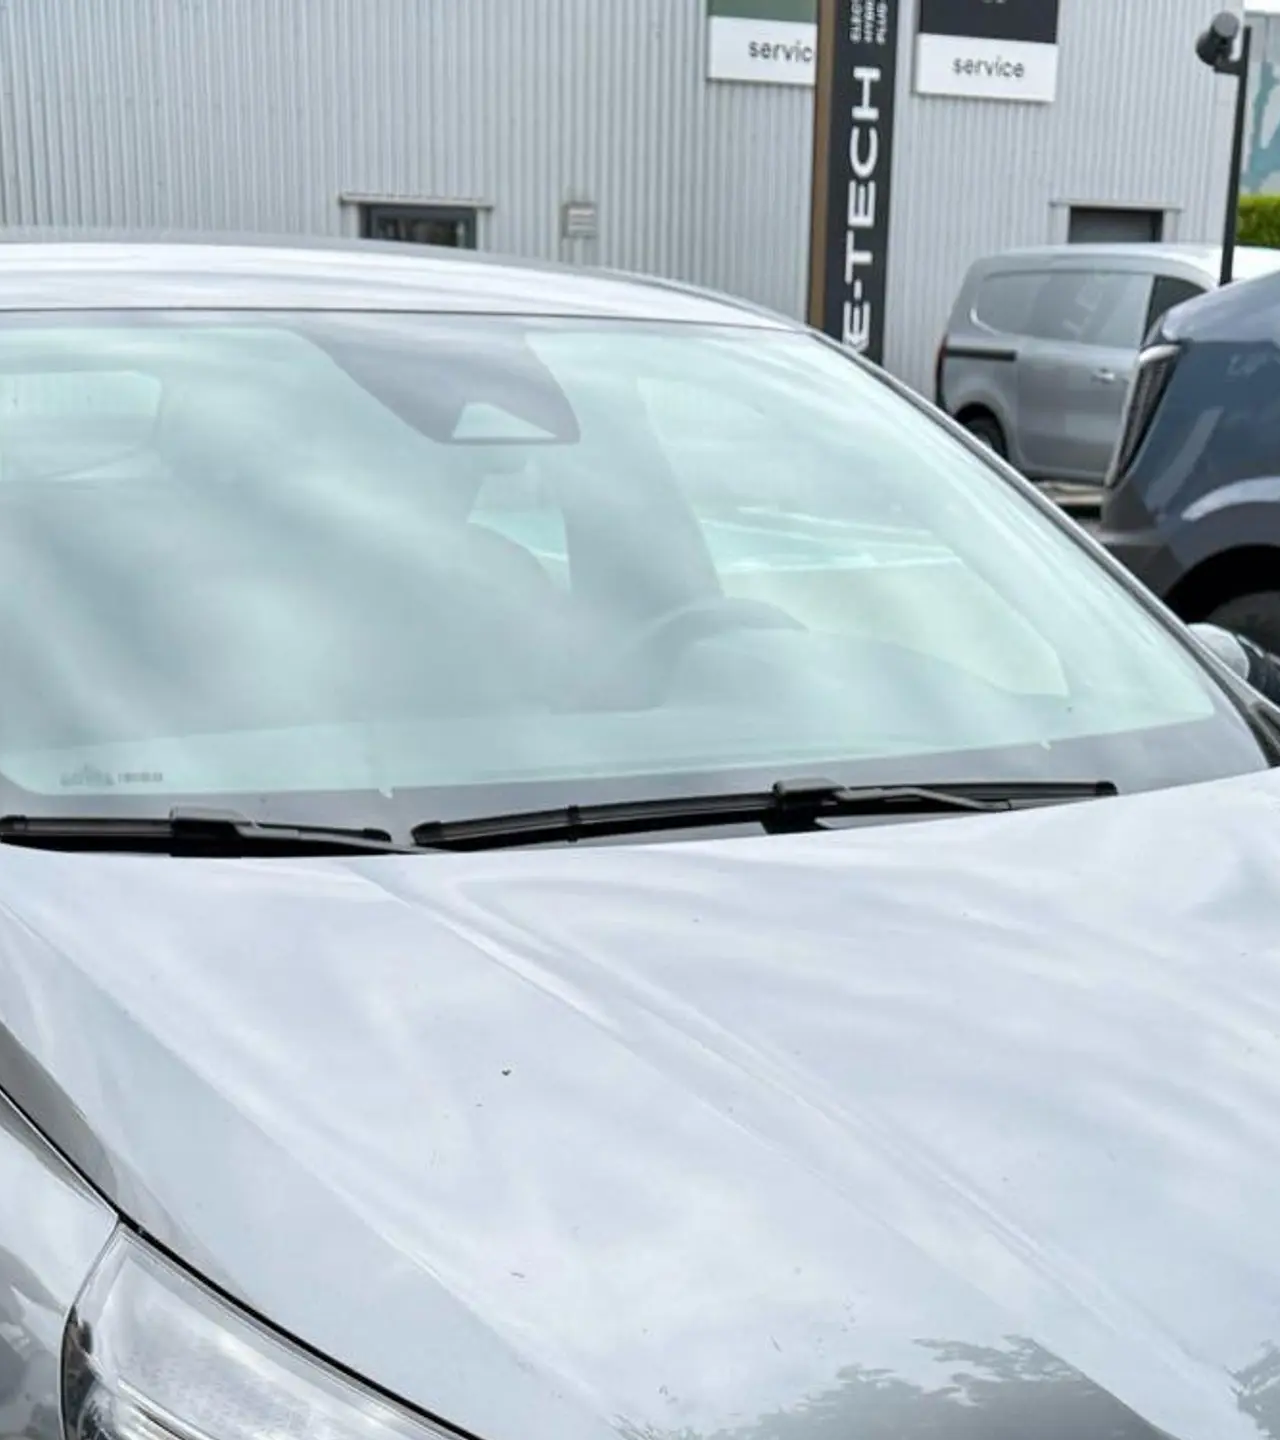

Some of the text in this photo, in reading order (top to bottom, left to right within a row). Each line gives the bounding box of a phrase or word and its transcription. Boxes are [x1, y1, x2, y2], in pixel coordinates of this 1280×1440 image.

[748, 39, 814, 63] servic
[951, 54, 1025, 79] service
[842, 66, 881, 352] E-TECH
